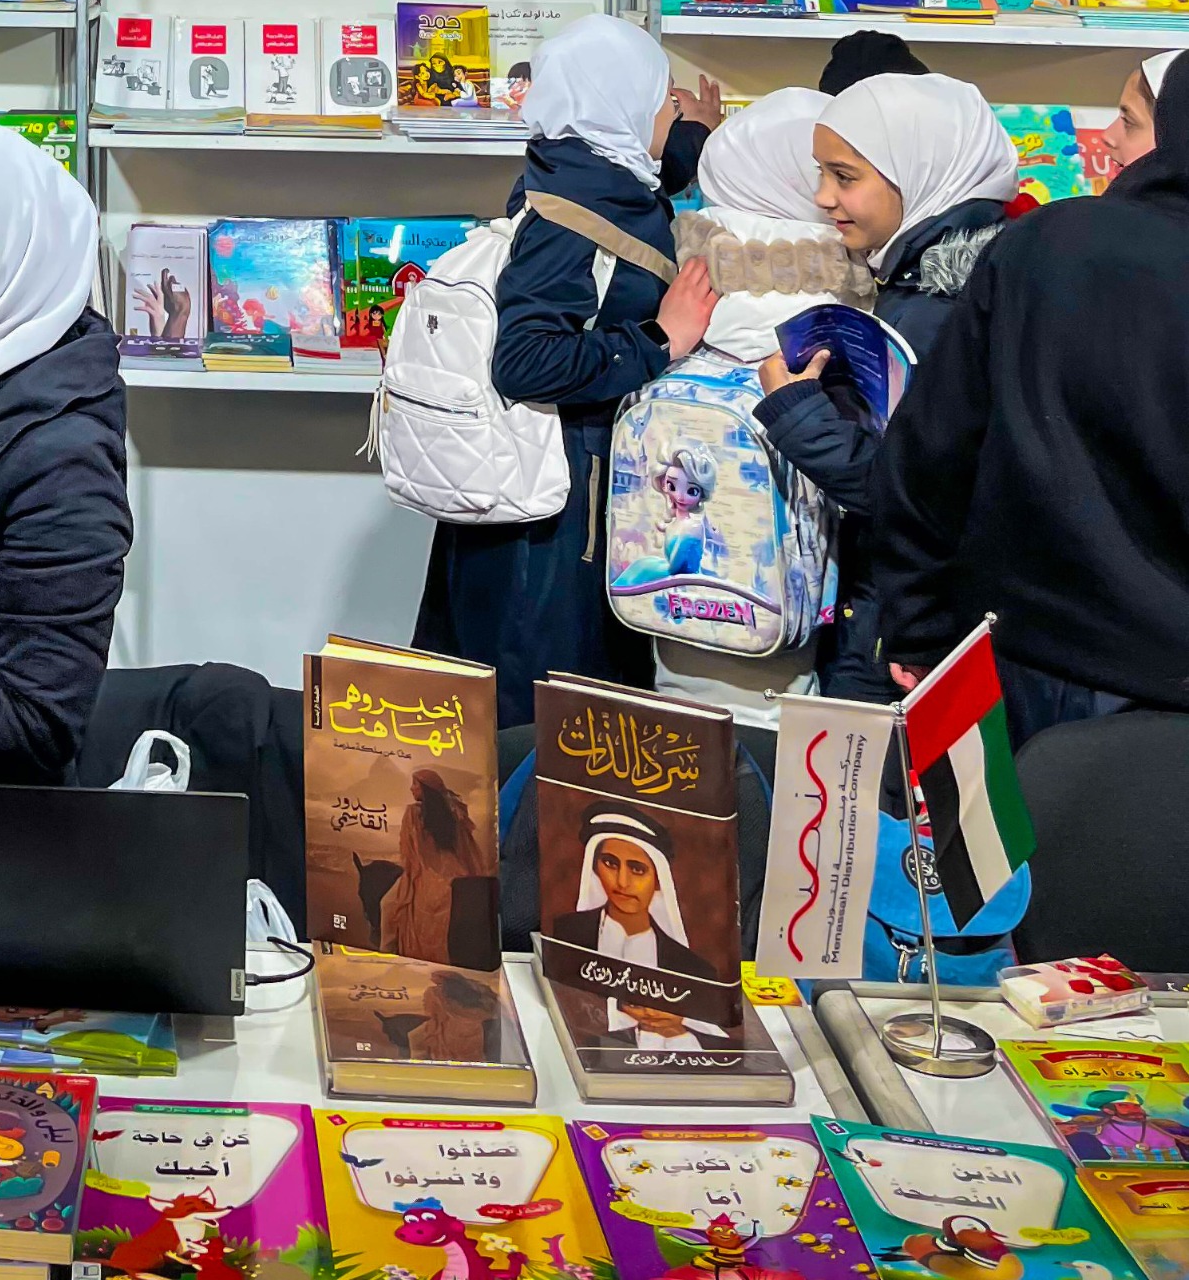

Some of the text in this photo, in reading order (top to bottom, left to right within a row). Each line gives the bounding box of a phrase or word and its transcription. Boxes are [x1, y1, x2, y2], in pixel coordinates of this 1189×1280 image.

[418, 14, 462, 30] حمد
[27, 122, 43, 134] IQ
[669, 593, 757, 630] FROZEN
[328, 707, 465, 757] أنها هنا
[838, 732, 855, 793] شركة
[331, 796, 387, 818] بدور
[330, 811, 389, 832] القاسمي
[830, 734, 868, 963] Menassah Distribution Company
[233, 970, 242, 999] Lenovo
[639, 977, 692, 1002] سلطان
[132, 1129, 184, 1146] حاجة
[193, 1131, 215, 1151] في
[155, 1157, 230, 1180] أخيك
